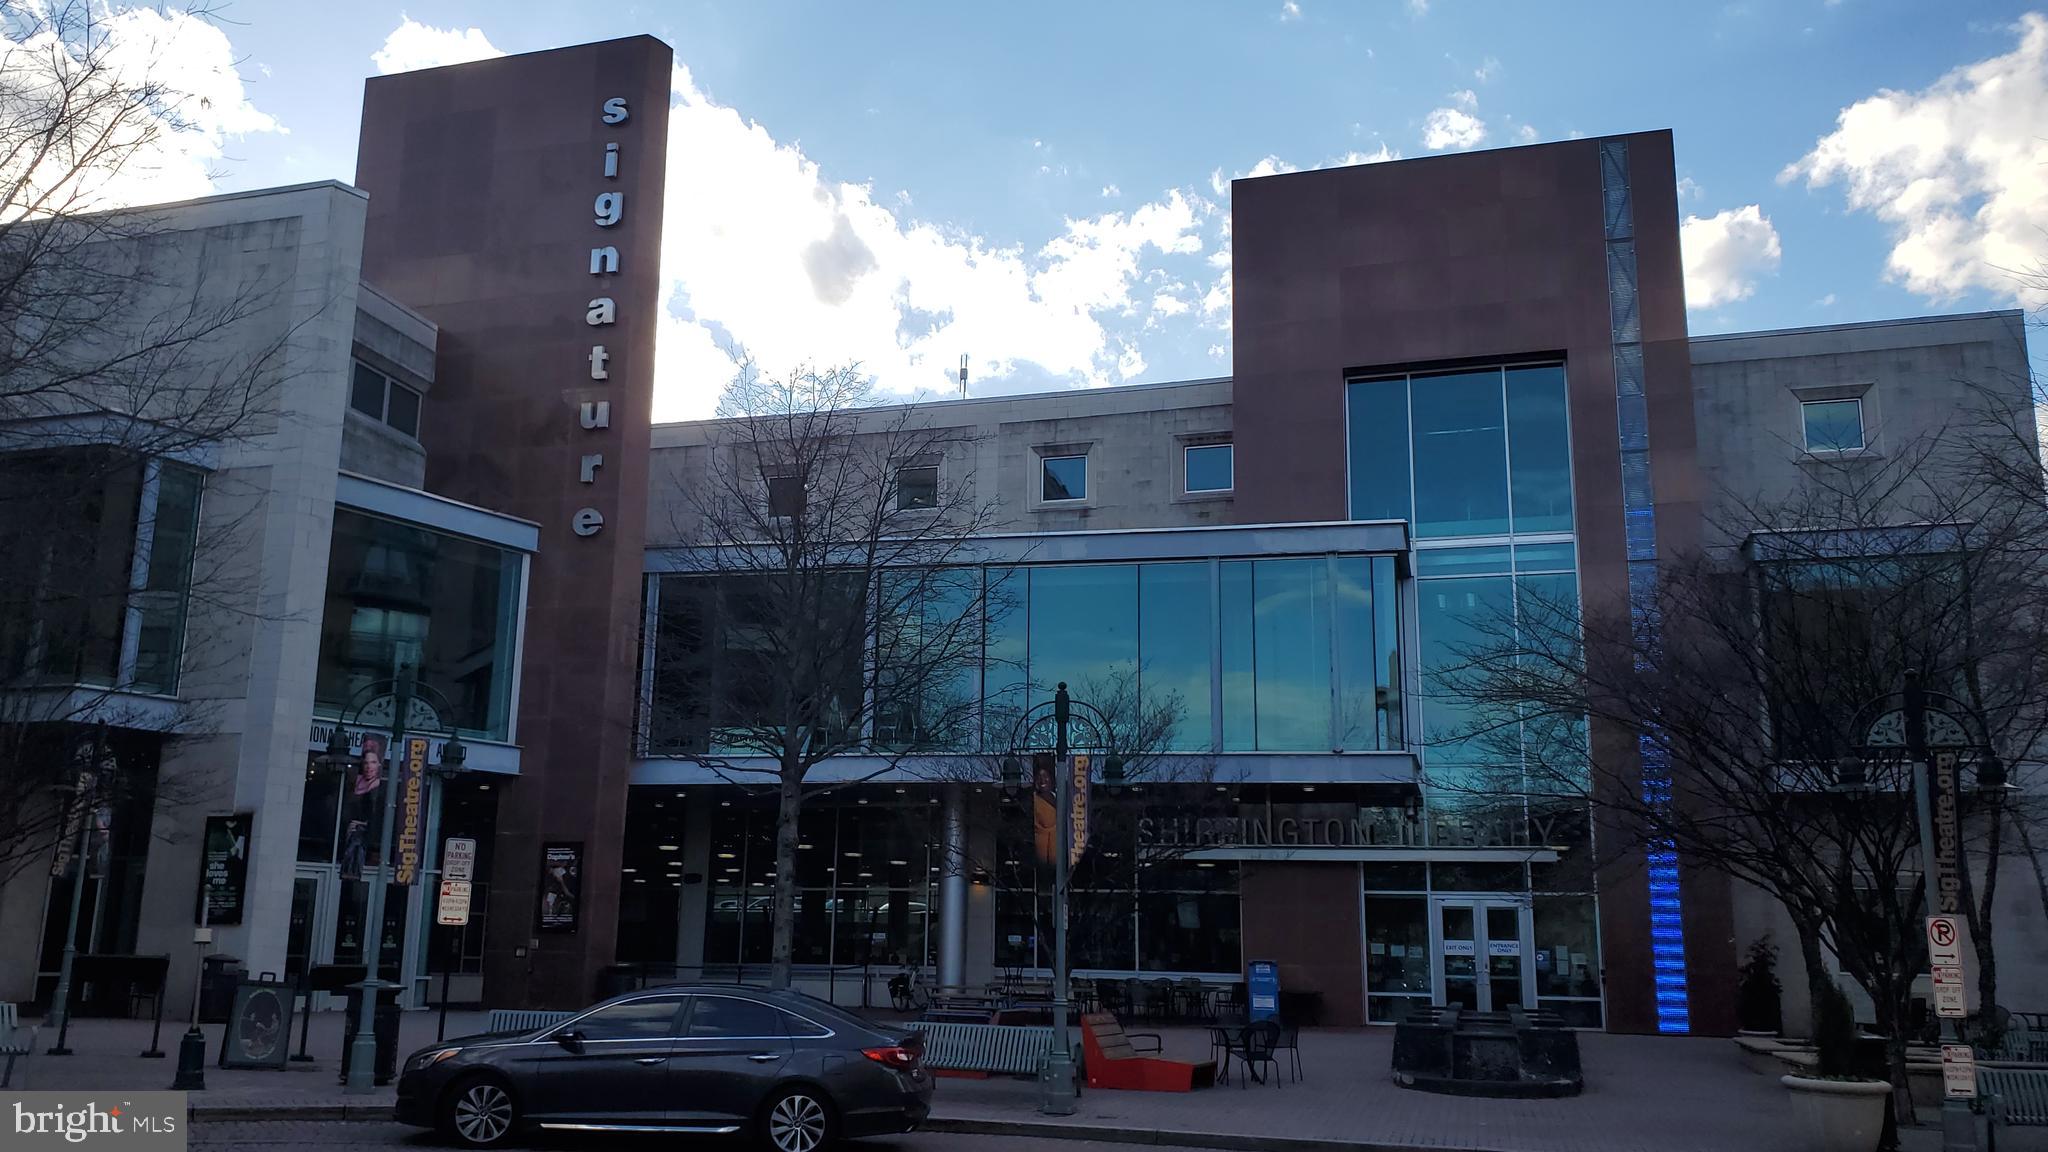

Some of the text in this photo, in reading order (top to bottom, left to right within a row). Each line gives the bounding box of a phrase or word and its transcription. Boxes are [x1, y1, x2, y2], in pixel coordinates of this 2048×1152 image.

[571, 97, 629, 537] signature
[396, 738, 427, 886] SigTheatre.org
[1138, 817, 1374, 846] SHIRINGTON
[1933, 752, 1961, 914] SigTheatre.org
[447, 851, 472, 859] PARKING
[455, 842, 466, 850] NO
[208, 861, 225, 870] she
[211, 877, 227, 885] me
